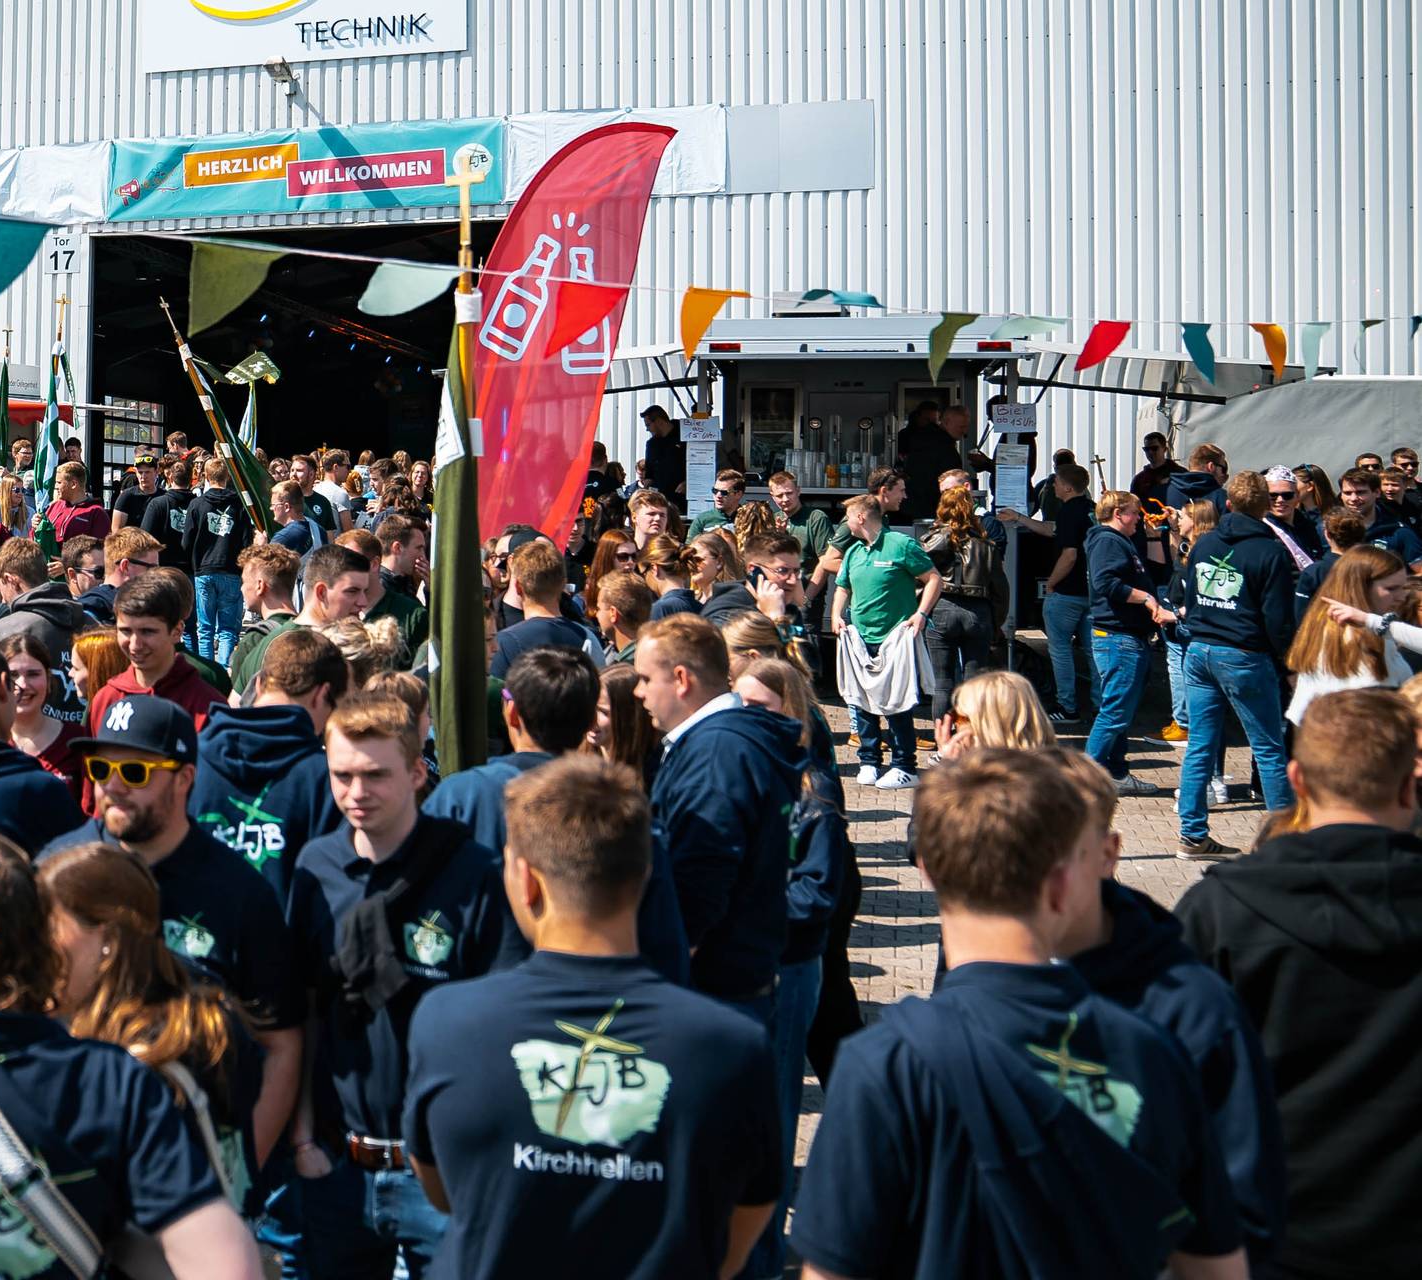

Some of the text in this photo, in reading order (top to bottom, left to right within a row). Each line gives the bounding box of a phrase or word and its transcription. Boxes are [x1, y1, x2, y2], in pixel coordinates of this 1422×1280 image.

[294, 13, 428, 43] TECHNIK
[197, 154, 283, 177] HERZLICH
[298, 159, 432, 187] WILLKOMMEN
[53, 236, 70, 246] Tor
[49, 250, 75, 271] 17
[997, 405, 1027, 416] Bier
[1201, 568, 1237, 587] KLJB
[61, 650, 72, 662] KL
[42, 703, 84, 721] ENNIGE
[212, 821, 285, 860] KLJB
[538, 1055, 646, 1106] KLJB
[512, 1141, 664, 1182] Kirchhellen
